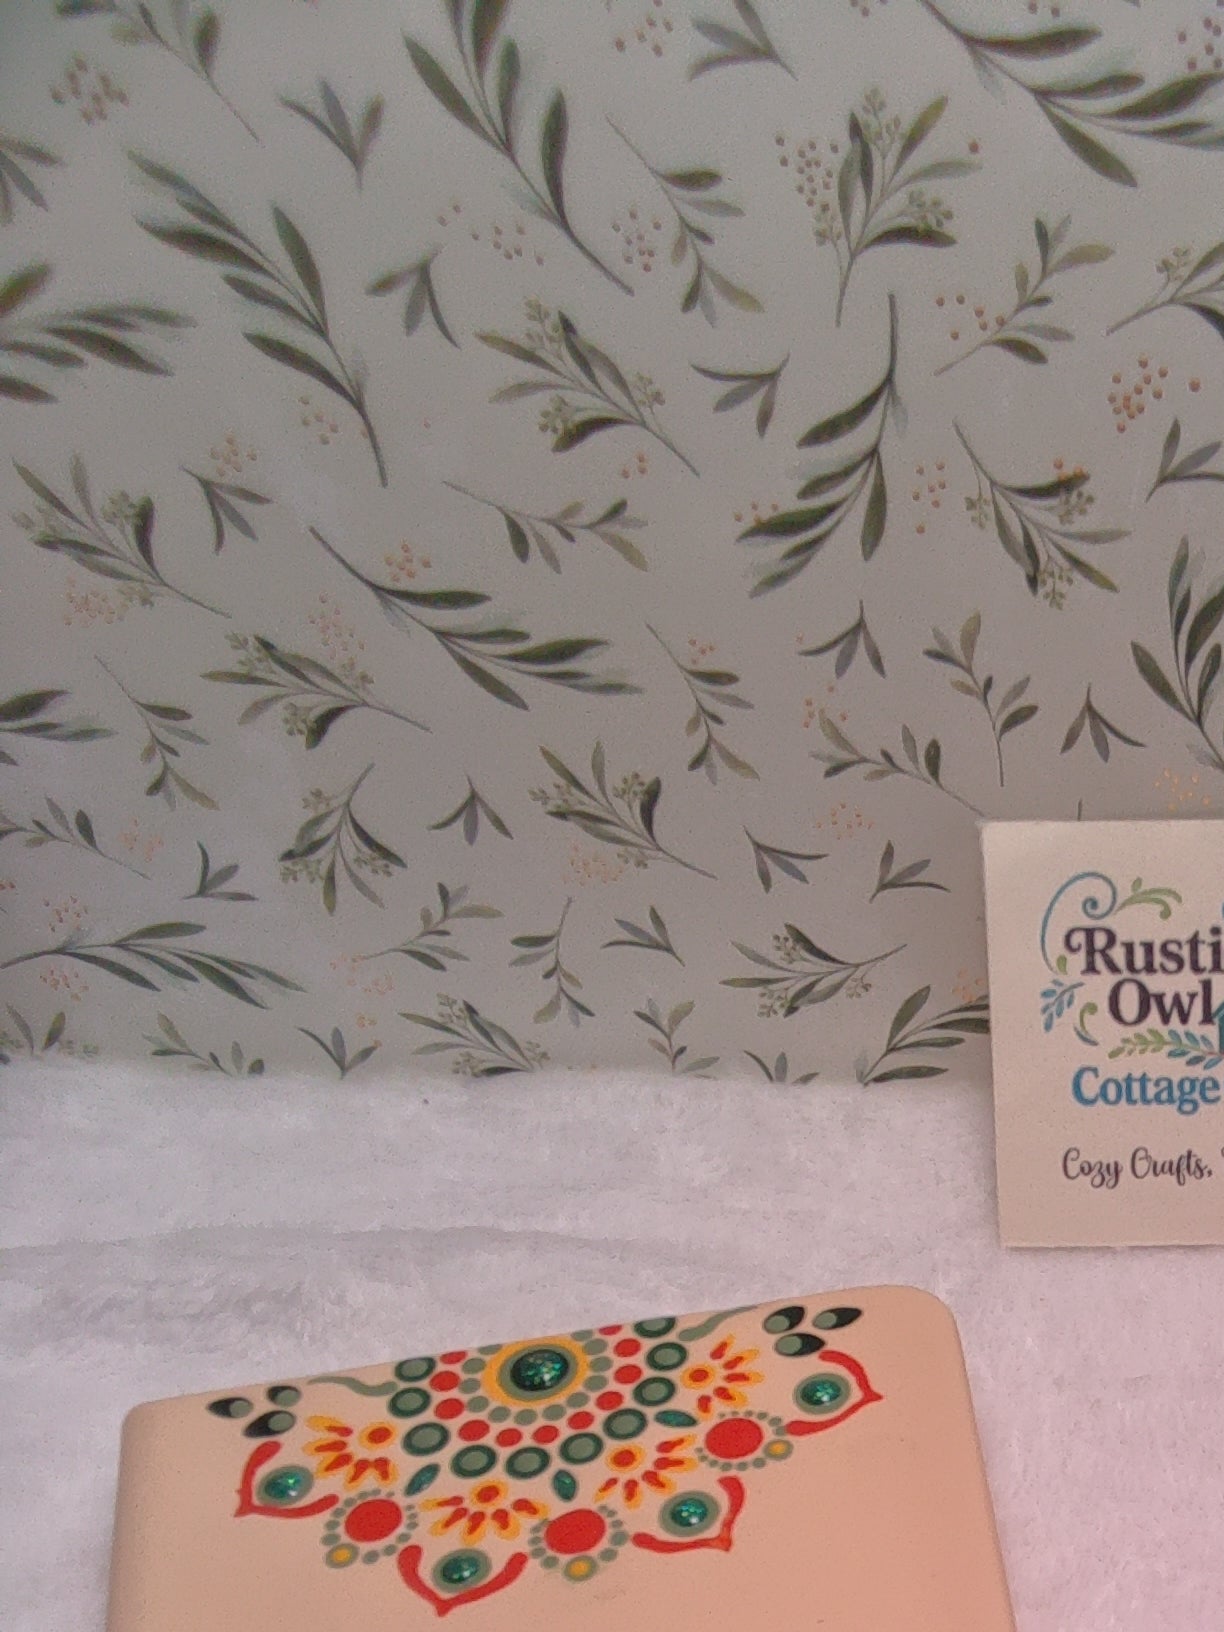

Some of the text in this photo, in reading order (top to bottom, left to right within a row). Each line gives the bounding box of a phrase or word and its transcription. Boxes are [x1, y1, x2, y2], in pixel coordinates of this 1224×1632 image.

[1108, 978, 1214, 1027] Owl
[1073, 1065, 1220, 1115] Cottage
[1062, 1148, 1123, 1189] Cozy
